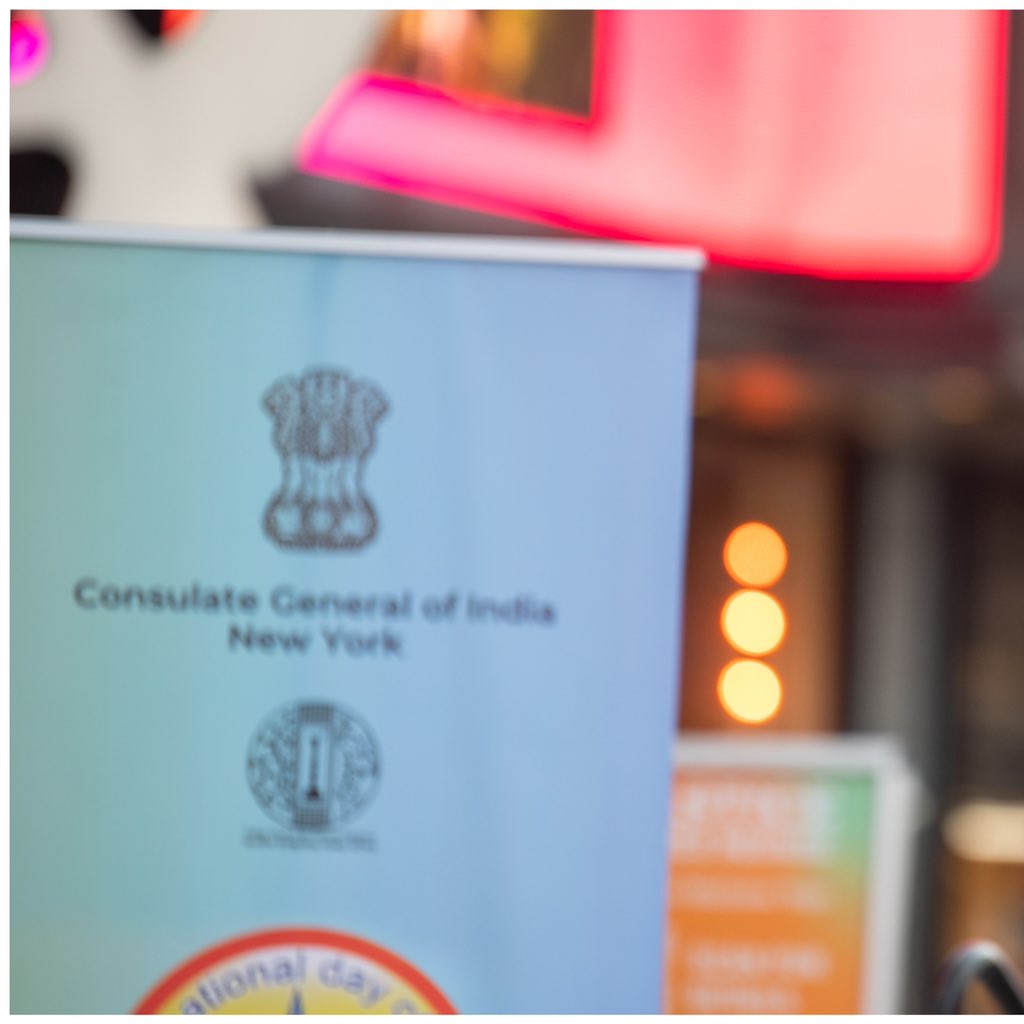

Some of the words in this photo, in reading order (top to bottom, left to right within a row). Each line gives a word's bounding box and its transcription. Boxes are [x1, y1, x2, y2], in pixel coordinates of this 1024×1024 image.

[73, 576, 259, 617] Consulate
[269, 583, 412, 622] General
[419, 587, 456, 623] of
[466, 590, 557, 628] India
[227, 623, 310, 655] New
[321, 626, 406, 660] York
